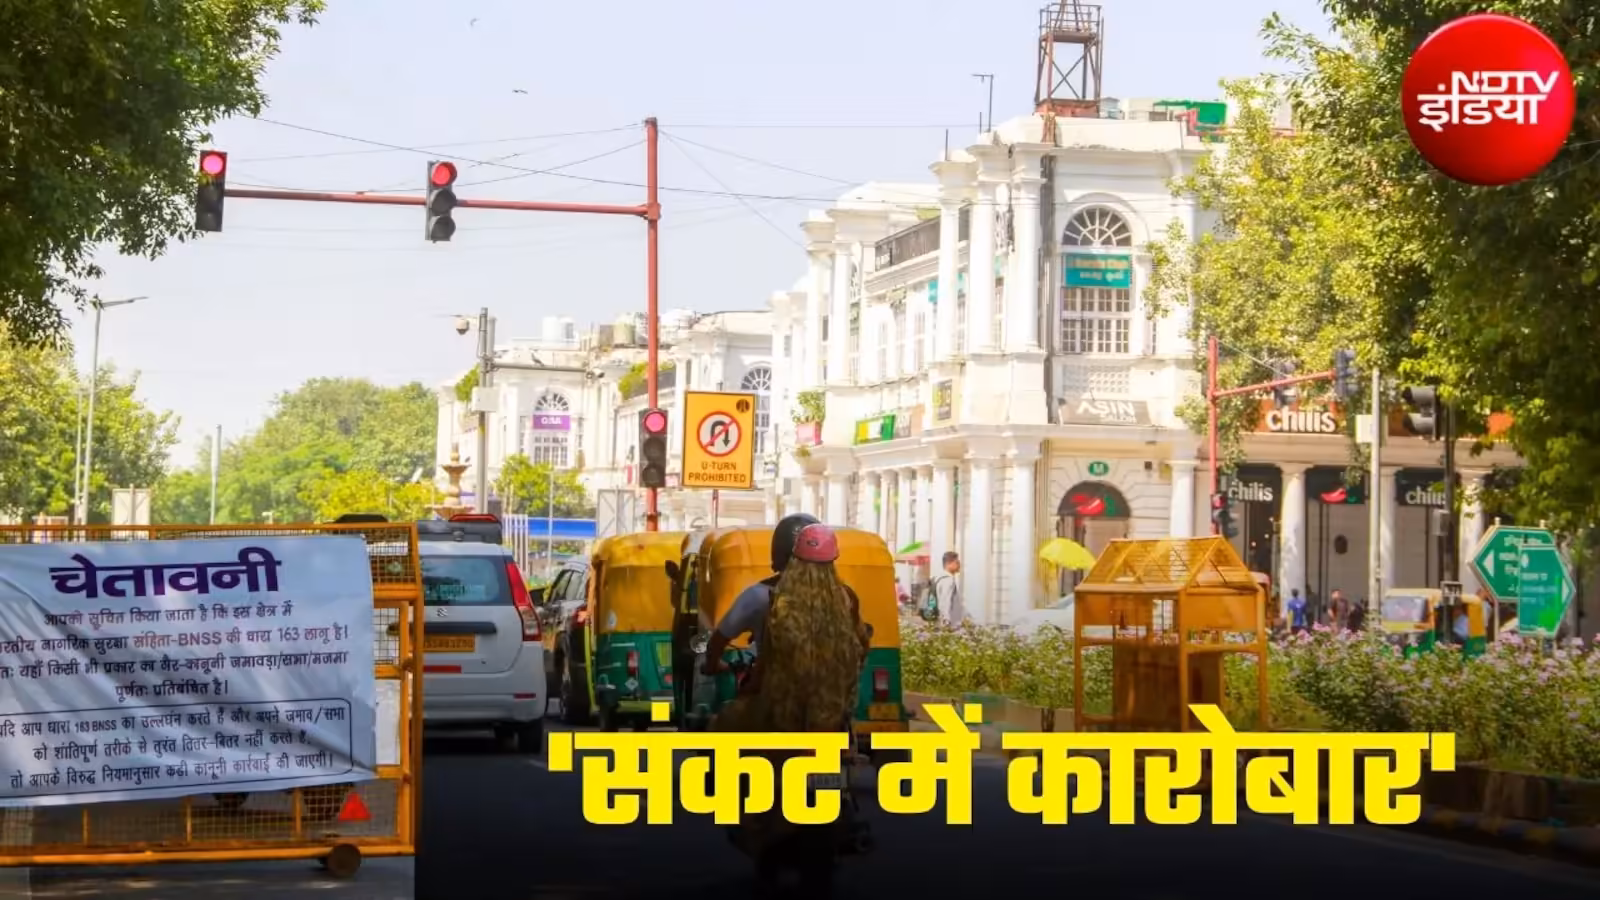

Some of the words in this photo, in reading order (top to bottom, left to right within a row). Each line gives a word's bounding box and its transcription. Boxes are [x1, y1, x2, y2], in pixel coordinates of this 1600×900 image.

[1266, 405, 1336, 432] chilis
[688, 472, 746, 483] PROHIBITED
[701, 461, 737, 470] U-TURN
[1228, 481, 1273, 501] chilis
[49, 546, 282, 598] चेतावनी
[44, 610, 83, 626] आपको
[89, 609, 126, 630] सूचित
[130, 607, 161, 624] किया
[165, 609, 195, 621] जाता
[200, 604, 208, 621] है
[212, 603, 228, 619] कि
[233, 607, 251, 619] इस
[256, 602, 278, 617] क्षेत्र
[281, 600, 293, 617] में
[41, 634, 90, 651] नागरिक
[94, 636, 129, 655] सुरक्षा
[133, 631, 222, 649] संहिता-BNSS
[226, 626, 242, 644] की
[247, 630, 272, 643] धारा
[278, 627, 300, 641] 163
[304, 628, 330, 644] लागू
[333, 622, 349, 640] है।
[0, 666, 14, 680] तः
[19, 658, 44, 679] यहाँ
[47, 658, 81, 677] किसी
[84, 657, 101, 676] भी
[104, 661, 136, 674] प्रकार
[140, 659, 157, 673] का
[160, 652, 227, 674] गैर-कानूनी
[229, 650, 349, 671] जमावड़ा/सभा/मजमा
[115, 681, 149, 703] पूर्णतः
[152, 678, 210, 697] प्रतिबंधित
[212, 678, 229, 696] है।
[21, 721, 43, 737] आप
[47, 719, 71, 735] धारा
[74, 721, 91, 733] 163
[92, 719, 117, 733] BNSS
[121, 716, 136, 730] का
[187, 707, 211, 725] करते
[230, 707, 251, 724] और
[255, 706, 279, 724] अपने
[32, 743, 47, 761] को
[54, 739, 98, 763] शांतिपूर्ण
[104, 737, 131, 757] तरीके
[138, 736, 147, 752] से
[153, 736, 177, 759] तुरंत
[182, 732, 240, 752] तितर-बितर
[244, 728, 264, 748] नहीं
[270, 729, 293, 745] करते
[10, 769, 23, 789] तो
[29, 767, 61, 788] आपके
[66, 765, 97, 786] विरुद्ध
[102, 763, 161, 785] नियमानुसार
[194, 756, 227, 780] कानूनी
[232, 752, 271, 774] कार्रवाई
[276, 752, 291, 769] की
[295, 751, 334, 769] जाएगी।
